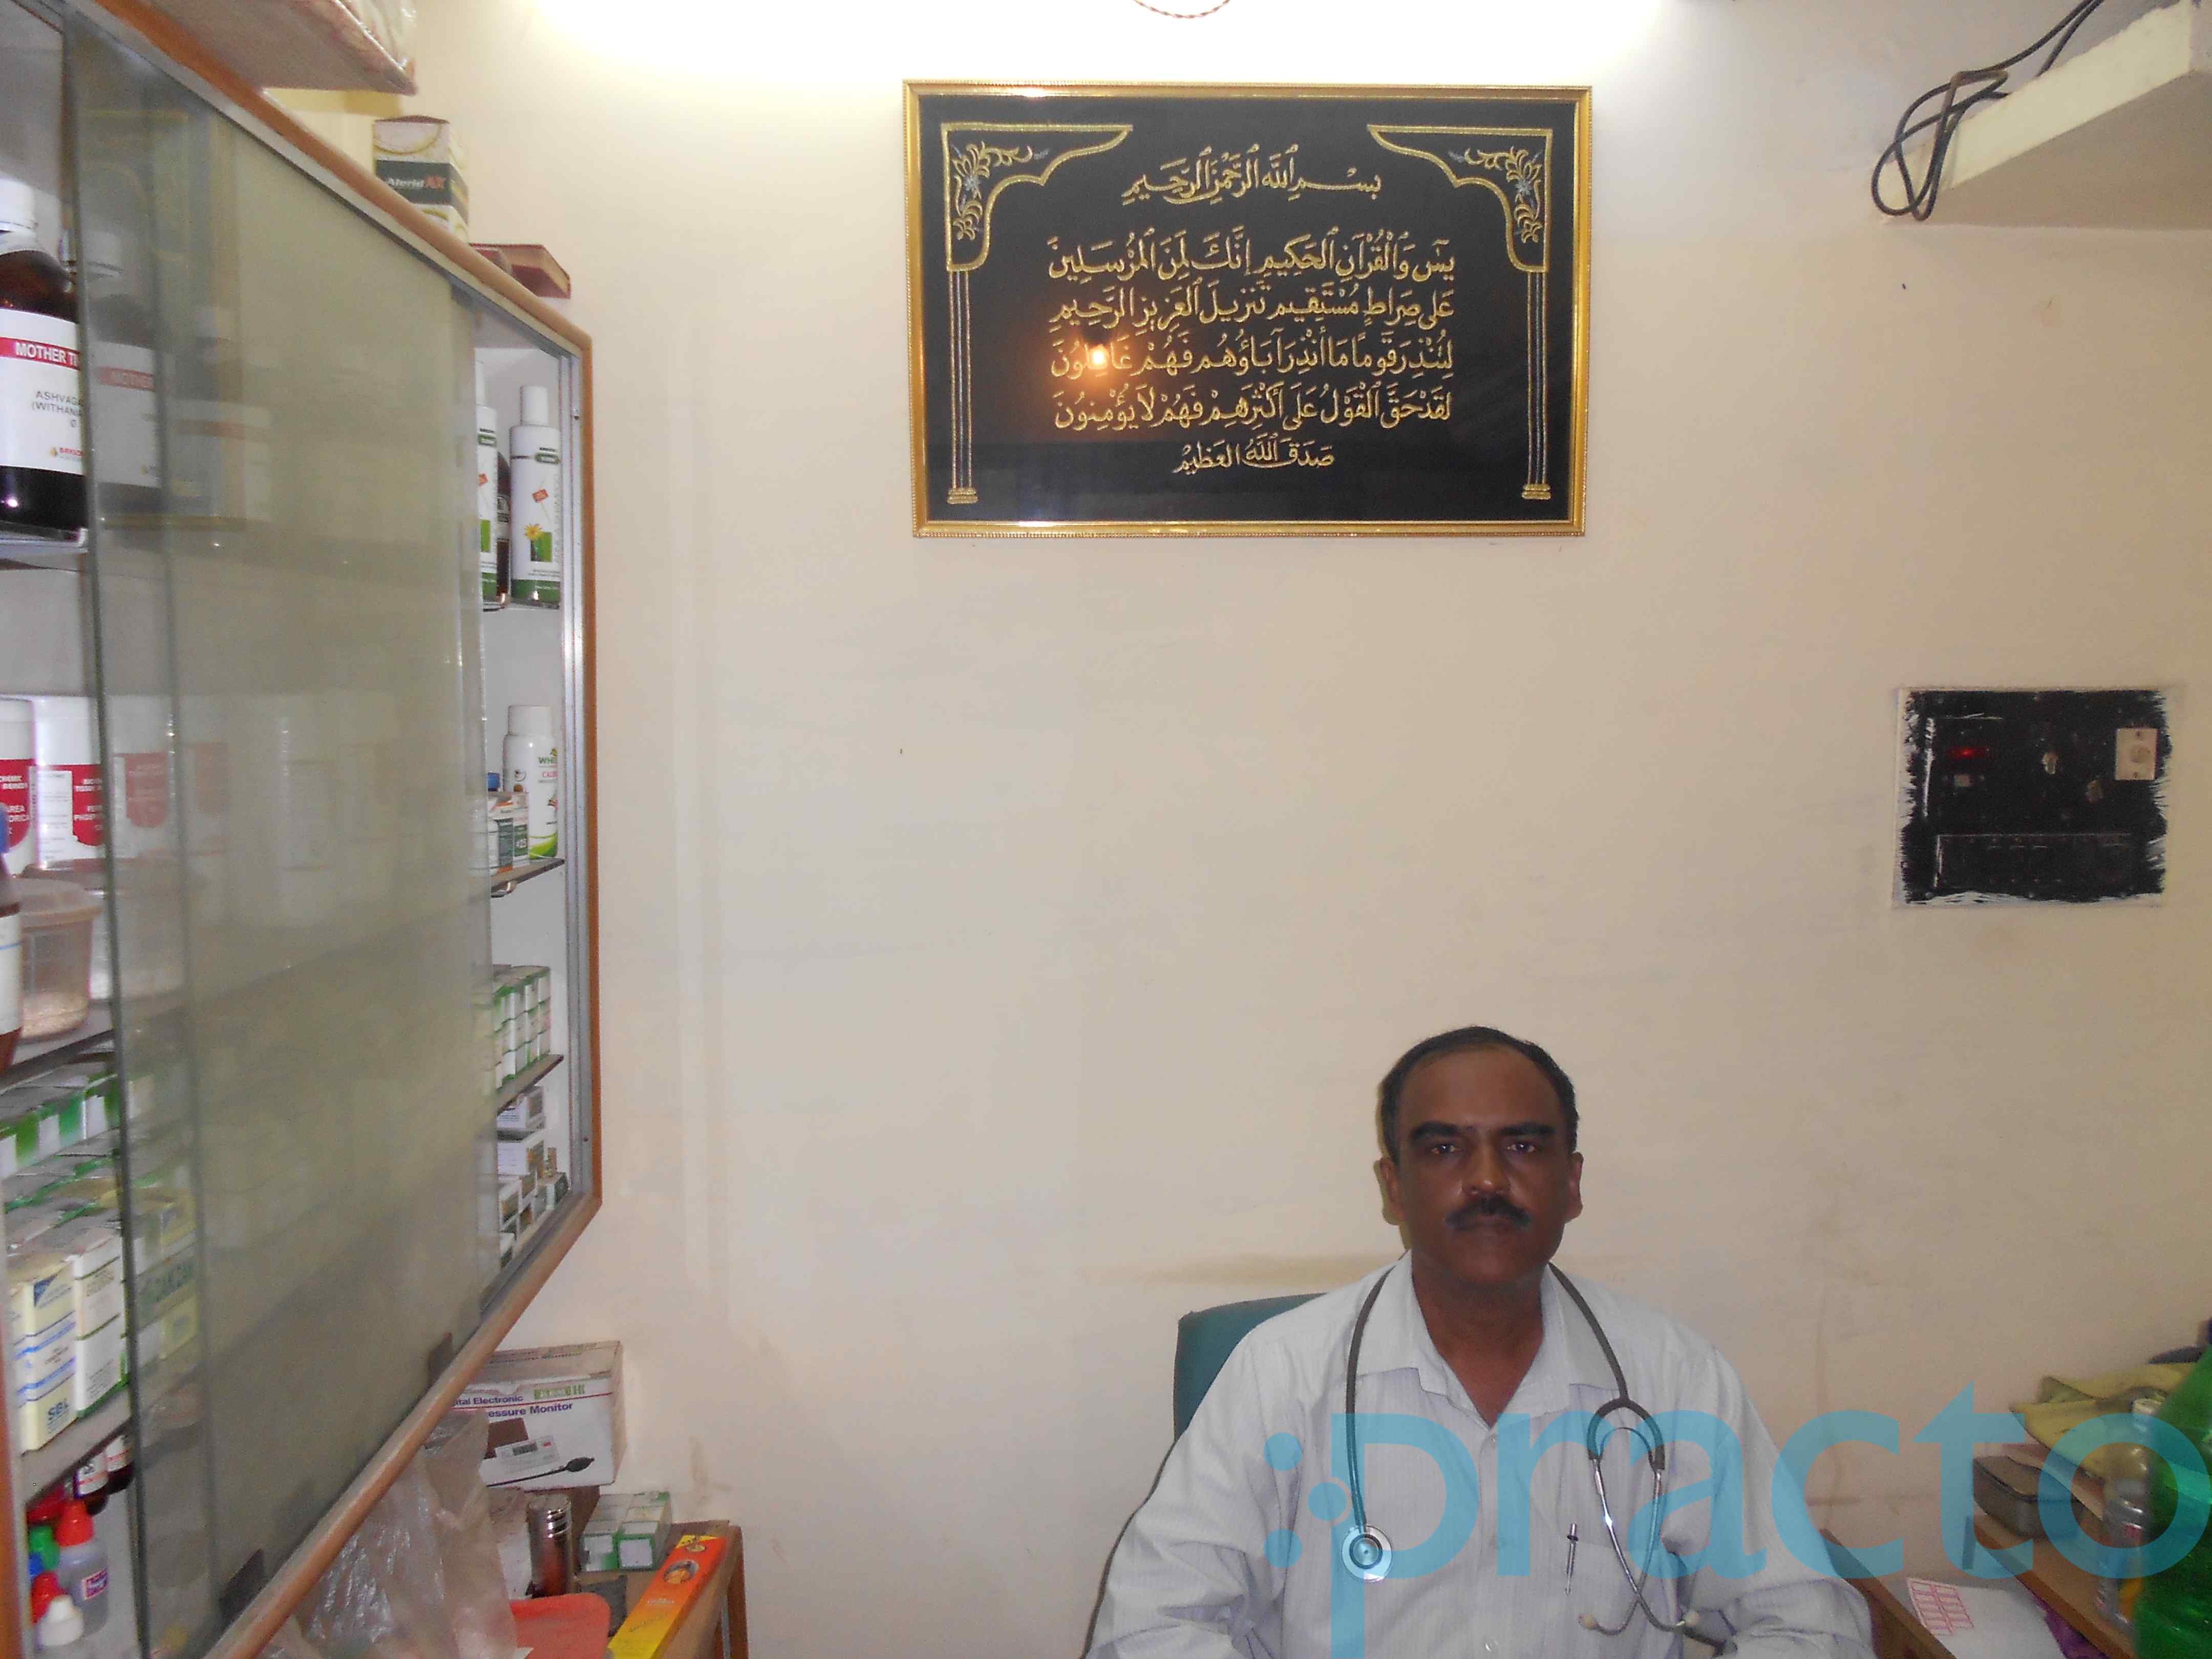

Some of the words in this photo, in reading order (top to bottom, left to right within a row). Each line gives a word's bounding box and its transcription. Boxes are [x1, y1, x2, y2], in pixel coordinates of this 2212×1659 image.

[16, 342, 67, 364] MOTHER
[473, 1394, 524, 1405] Electronic
[488, 1408, 526, 1418] essure
[530, 1402, 573, 1415] Monitor
